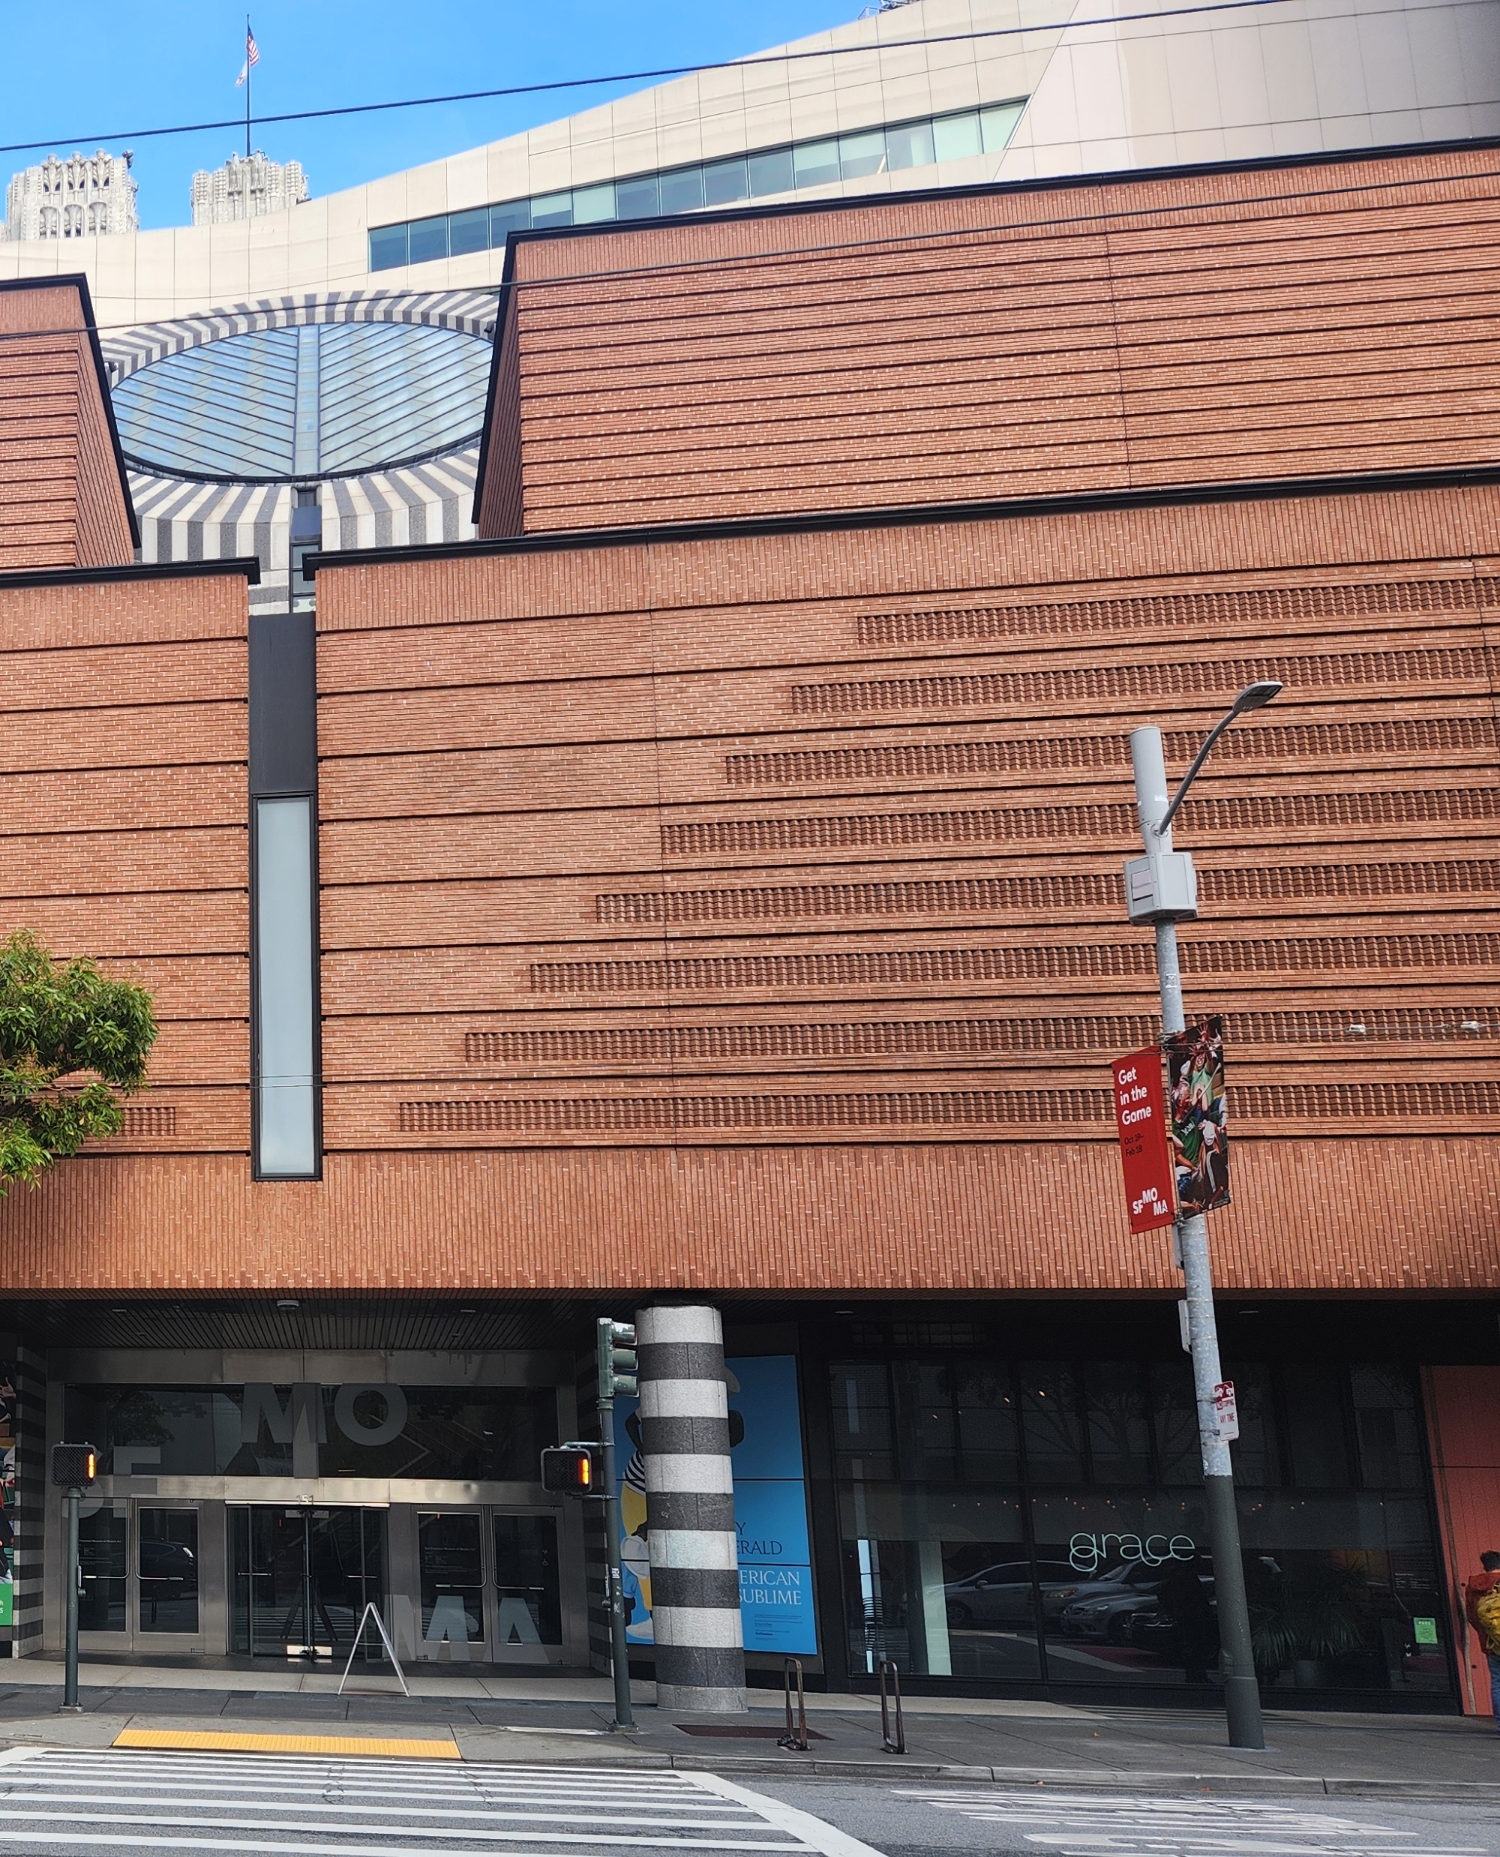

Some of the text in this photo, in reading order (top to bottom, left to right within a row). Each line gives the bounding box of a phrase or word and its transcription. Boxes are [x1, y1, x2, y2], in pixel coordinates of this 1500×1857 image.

[1118, 1066, 1137, 1085] Get
[1119, 1085, 1148, 1106] in the
[1121, 1106, 1152, 1126] Game
[1124, 1135, 1134, 1145] Oct
[1125, 1147, 1135, 1157] Feb
[1132, 1187, 1168, 1216] SF MO MA
[242, 1382, 408, 1447] MO
[296, 1494, 314, 1506] 151
[1069, 1532, 1196, 1572] grace
[739, 1569, 800, 1586] ERICAN
[382, 1594, 551, 1664] MA
